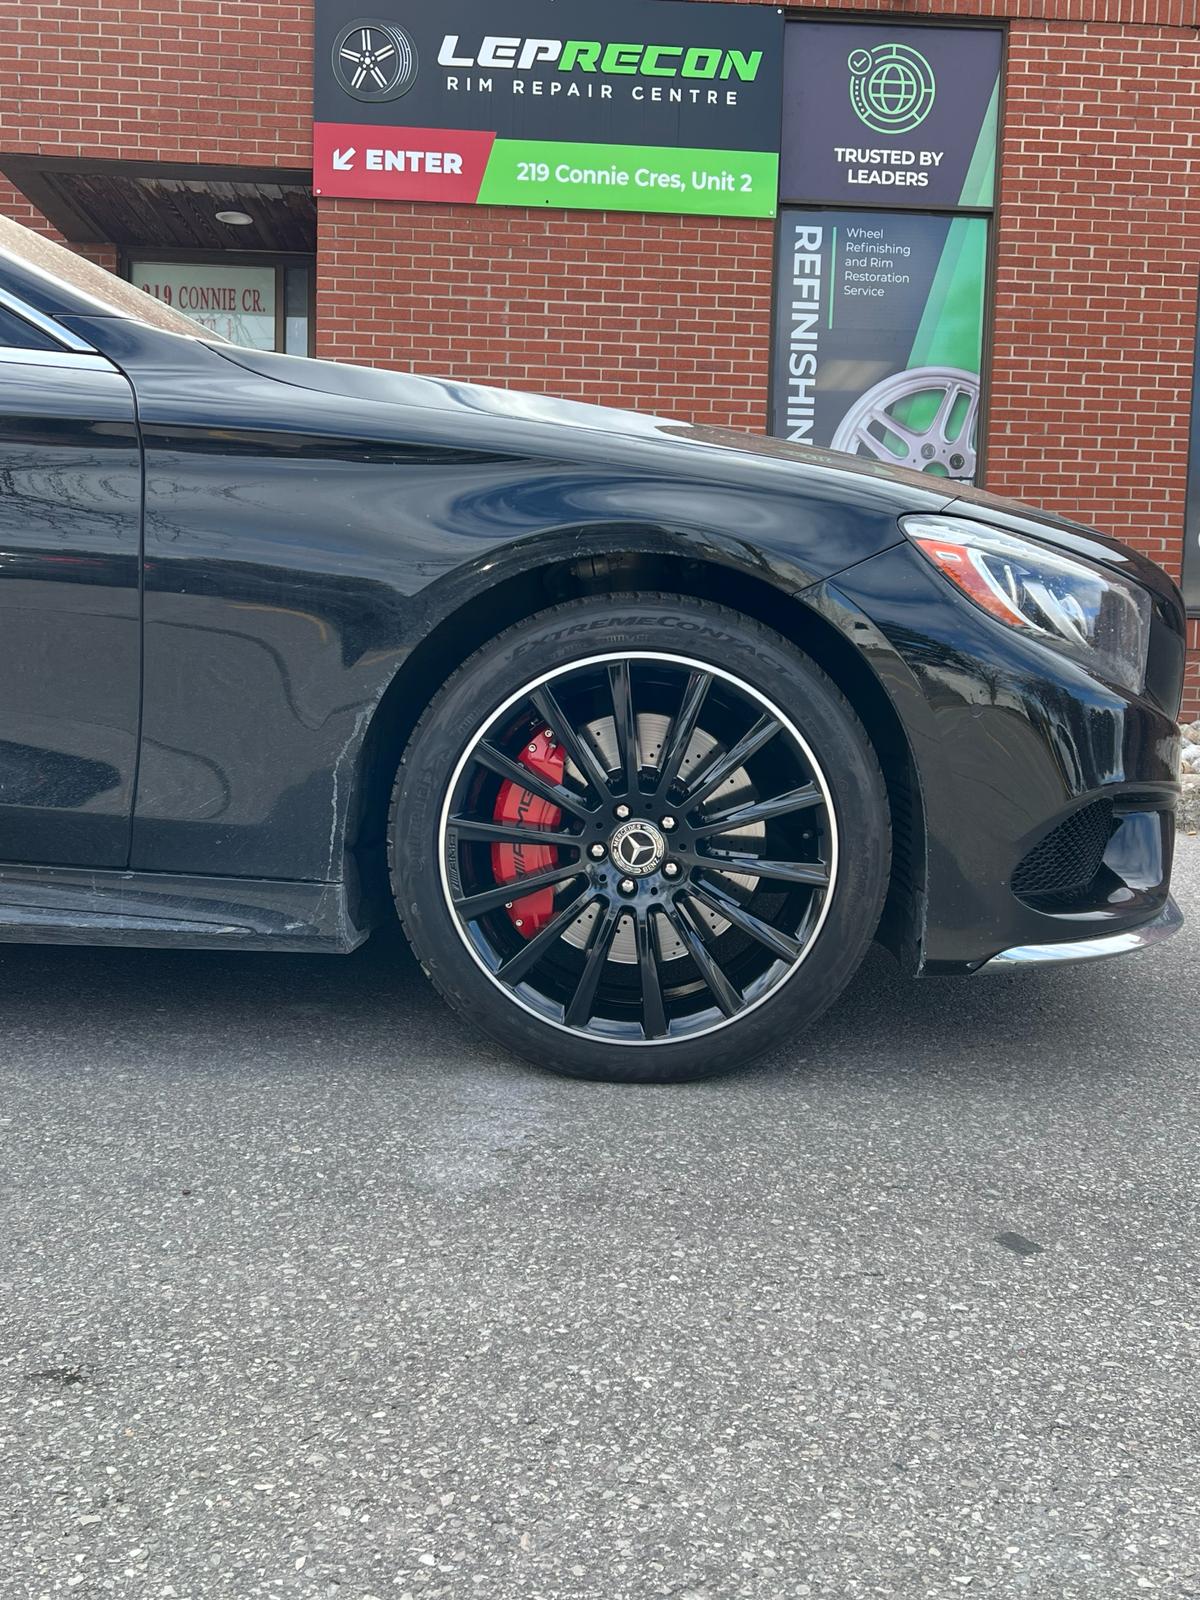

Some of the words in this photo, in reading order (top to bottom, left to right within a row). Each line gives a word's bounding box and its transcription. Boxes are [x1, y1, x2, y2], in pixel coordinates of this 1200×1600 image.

[437, 35, 763, 82] LEPRECON
[447, 76, 493, 93] RIM
[513, 79, 613, 98] REPAIR
[632, 86, 737, 105] CENTRE
[365, 149, 462, 175] ENTER
[834, 148, 915, 166] TRUSTED
[919, 151, 944, 167] BY
[516, 162, 549, 182] 219
[554, 164, 629, 186] Connie
[635, 168, 686, 192] Cres,
[691, 172, 736, 192] Unit
[740, 174, 753, 192] 2
[847, 169, 929, 187] LEADERS
[846, 227, 884, 240] Wheel
[846, 242, 911, 256] Refinishing
[844, 257, 867, 268] and
[871, 257, 893, 268] Rim
[844, 271, 910, 283] Restoration
[179, 286, 236, 311] CONNIE
[242, 289, 266, 313] CR.
[844, 285, 885, 297] Service
